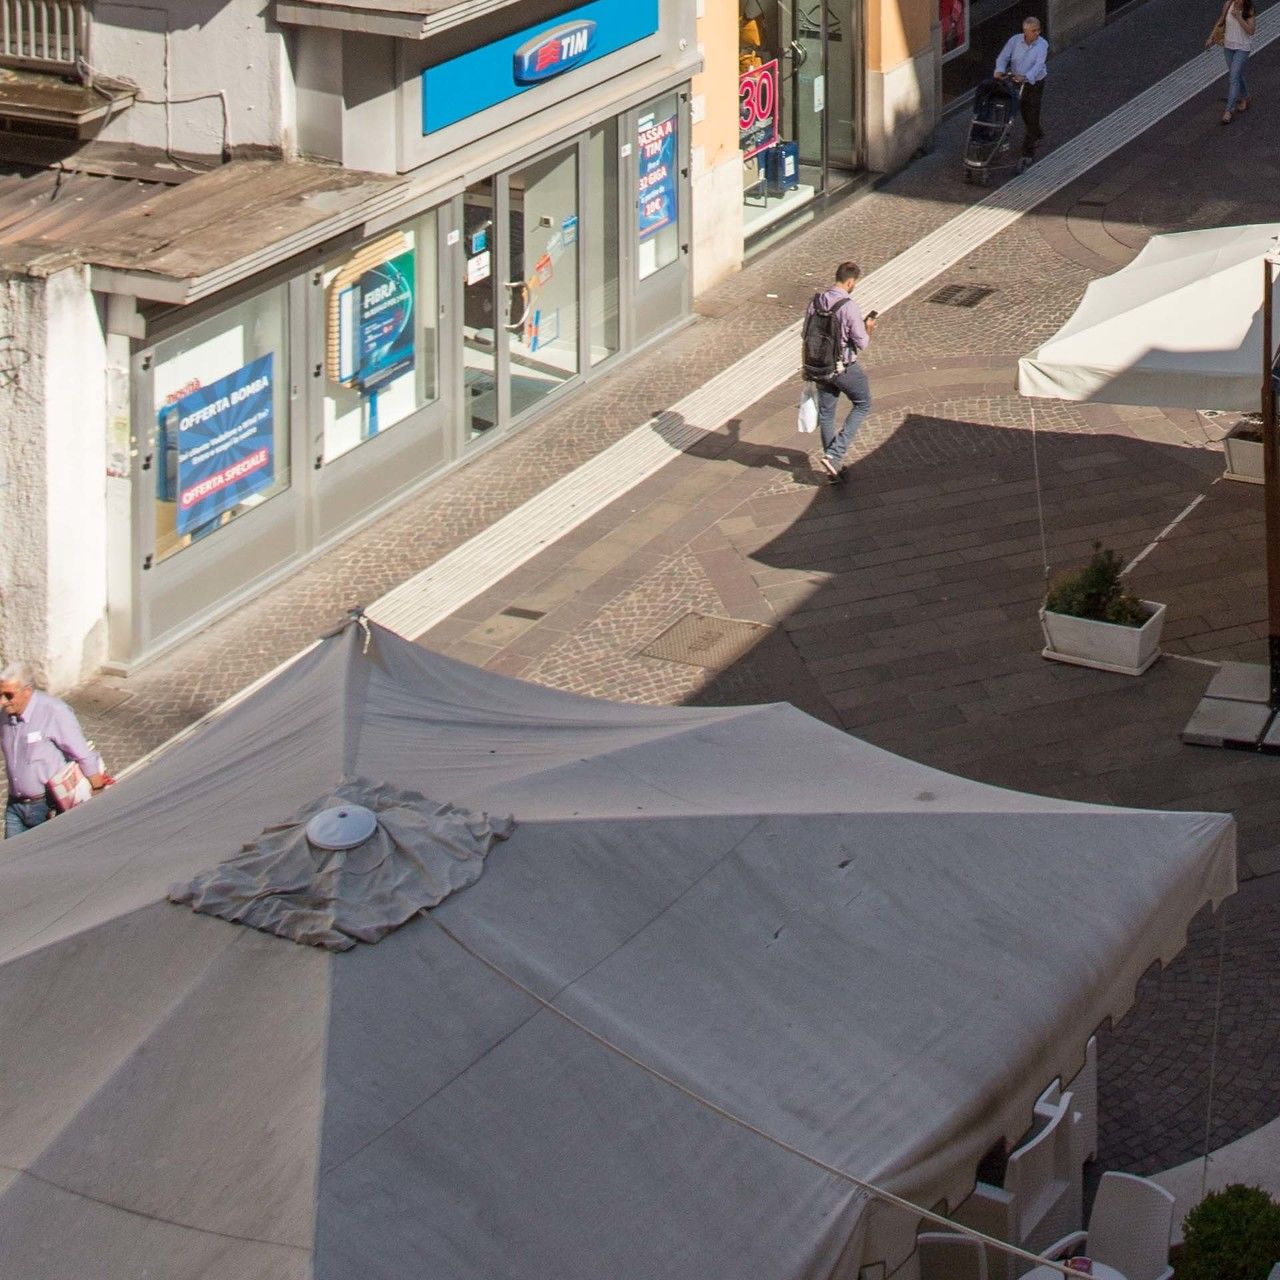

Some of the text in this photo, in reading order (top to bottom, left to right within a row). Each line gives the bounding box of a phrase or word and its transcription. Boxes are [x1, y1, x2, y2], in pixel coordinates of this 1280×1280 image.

[561, 29, 588, 60] TIM
[739, 71, 774, 130] 30
[364, 281, 397, 308] FIBRA
[180, 376, 269, 431] OFFERTA BOMBA
[182, 450, 268, 504] OFFERTA SPECIALE
